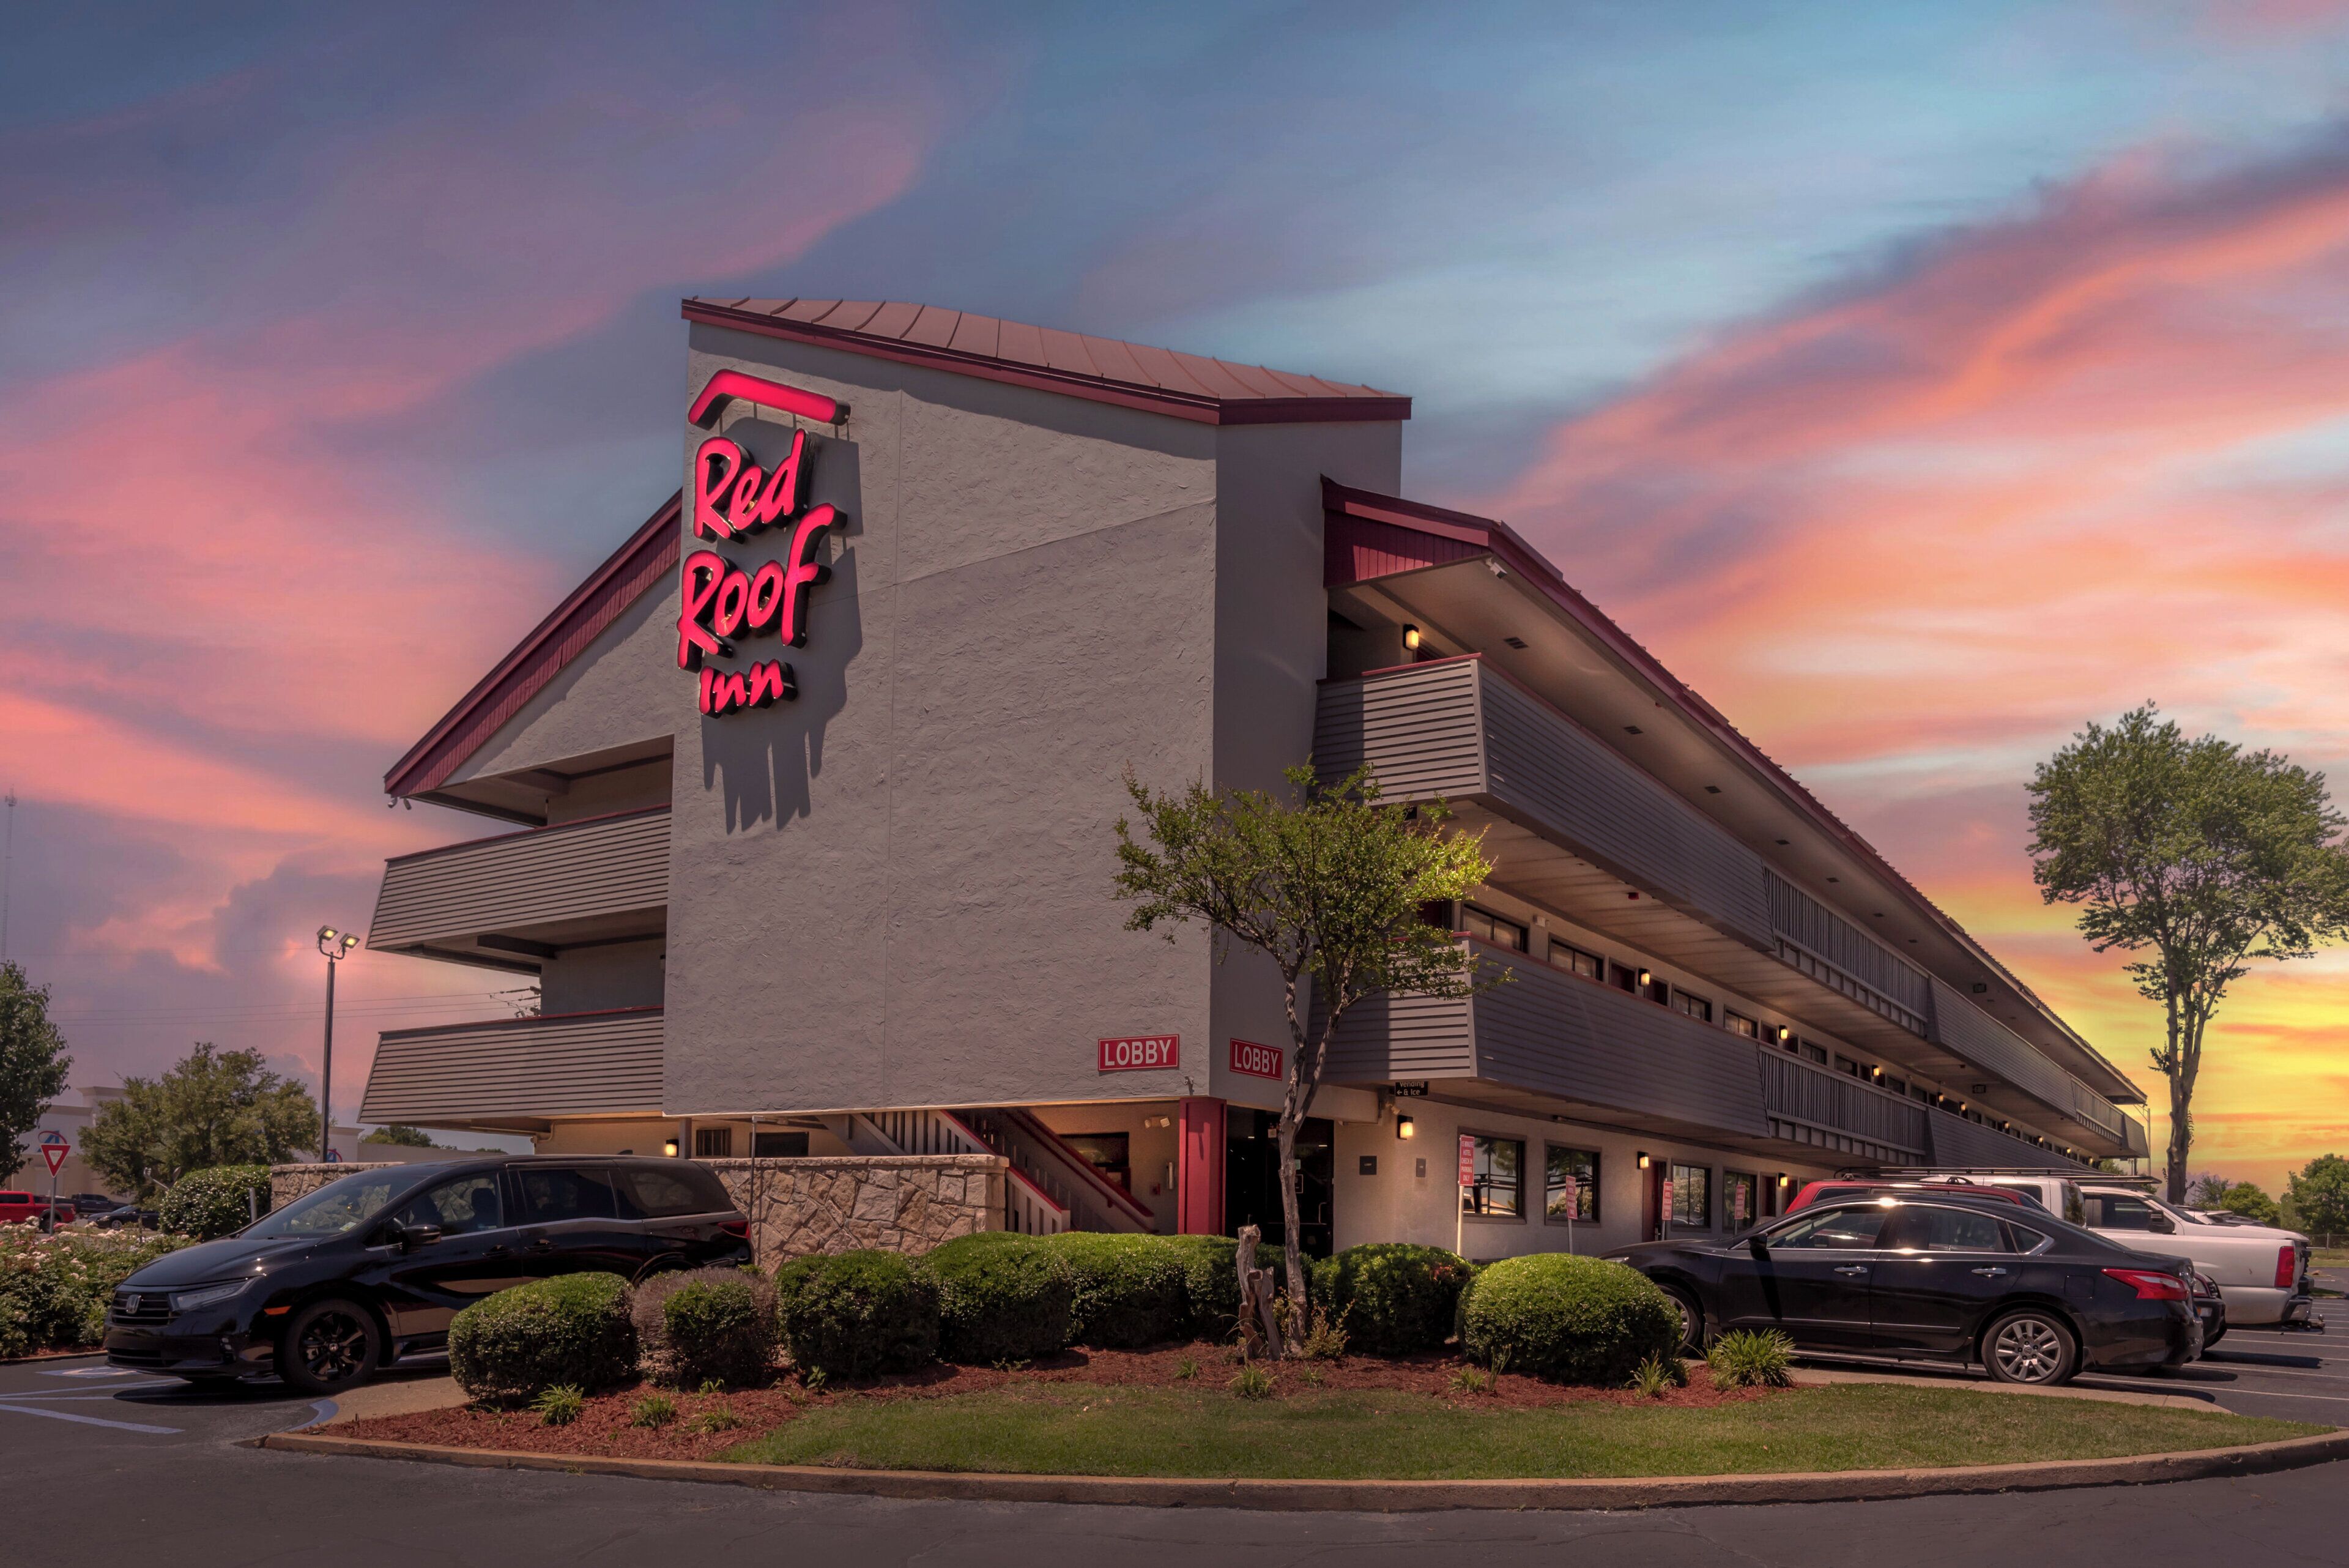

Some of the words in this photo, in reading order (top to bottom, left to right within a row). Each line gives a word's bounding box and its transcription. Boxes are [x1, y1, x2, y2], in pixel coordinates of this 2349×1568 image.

[693, 428, 806, 539] Red
[677, 502, 836, 670] Roof
[1104, 1039, 1172, 1066] LOBBY
[1234, 1044, 1279, 1075] LOBBY
